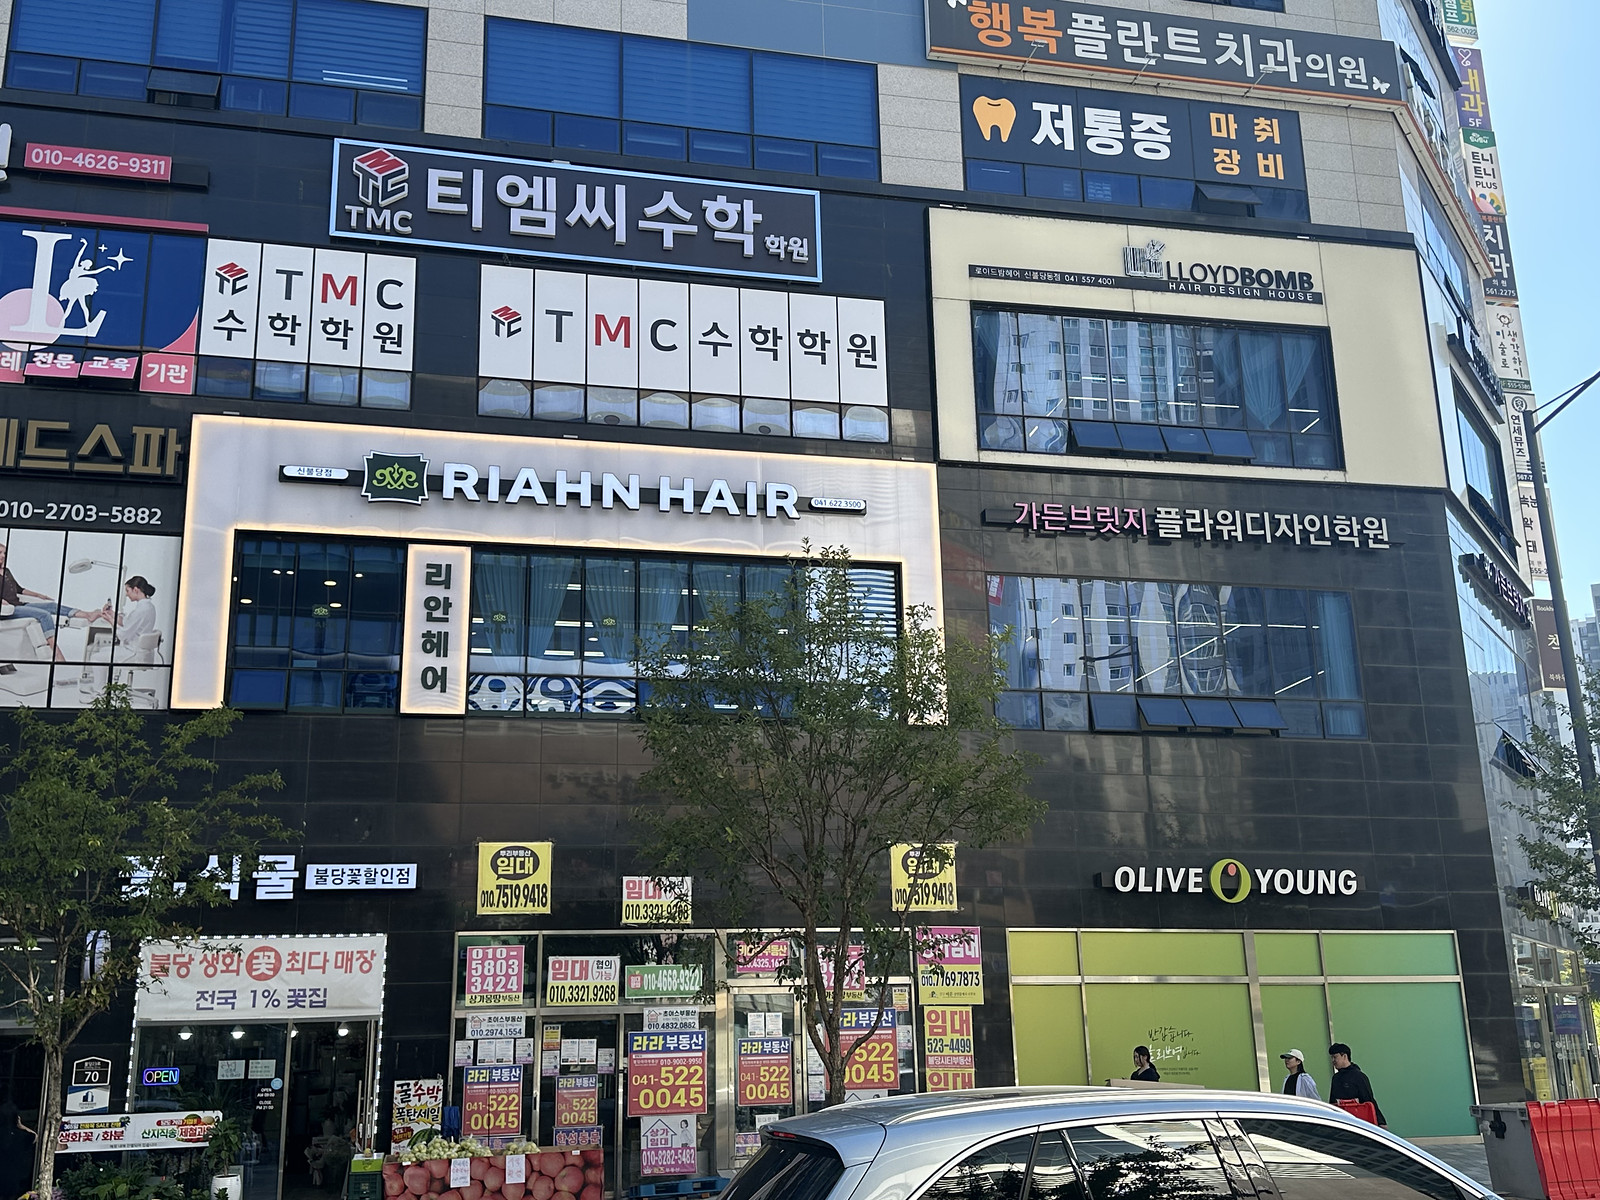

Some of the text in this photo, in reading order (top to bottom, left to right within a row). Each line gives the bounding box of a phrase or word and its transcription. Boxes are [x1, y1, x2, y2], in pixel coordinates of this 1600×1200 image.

[1461, 68, 1485, 117] 내과
[1032, 102, 1171, 160] 저통증
[1468, 117, 1482, 127] 5F
[31, 148, 166, 176] 010-4626-9311
[1475, 180, 1498, 190] PLUS
[344, 204, 414, 234] TMC
[426, 167, 810, 263] 티엠씨수학 학원
[1483, 224, 1510, 279] 치과
[1064, 274, 1079, 282] 041
[1097, 278, 1116, 286] 4001
[1166, 260, 1315, 292] LLOYDBOMB
[1168, 282, 1314, 302] HAIR DESIGN HOUSE
[1485, 287, 1516, 297] 561.2275
[0, 351, 188, 383] 레 전문 교육 기관
[442, 462, 801, 520] RIAHN HAIR
[0, 501, 162, 525] 010-2703-5882
[813, 498, 862, 509] 041.622.3500
[1013, 501, 1391, 549] 가든브릿지 플라워디자인학원
[420, 563, 453, 693] 리안헤어
[496, 857, 533, 875] 임대
[314, 867, 410, 886] 불당꽃할인점
[1114, 865, 1358, 895] OLIVE YOUNG
[480, 883, 548, 908] 010.7519.9418
[625, 880, 663, 900] 임대
[150, 949, 378, 979] 불당 생화 꽃 최다 매장
[471, 959, 519, 976] 5803
[551, 959, 589, 981] 임대
[470, 976, 518, 993] 3424
[549, 984, 616, 1003] 010.3321.9268
[195, 987, 328, 1010] 전국 1% 꽃집
[470, 1028, 523, 1036] 010.2974.1554
[926, 1009, 971, 1037] 임대
[666, 1034, 703, 1050] 부동산
[763, 1040, 789, 1054] 부동산
[926, 1037, 971, 1054] 523-4499
[84, 1071, 99, 1082] 70
[145, 1070, 178, 1083] OPEN
[492, 1067, 521, 1082] 부동산
[395, 1106, 440, 1123] 폭탄세일
[58, 1131, 94, 1143] 생화꽃
[101, 1130, 125, 1141] 화분
[141, 1127, 177, 1139] 산지직송
